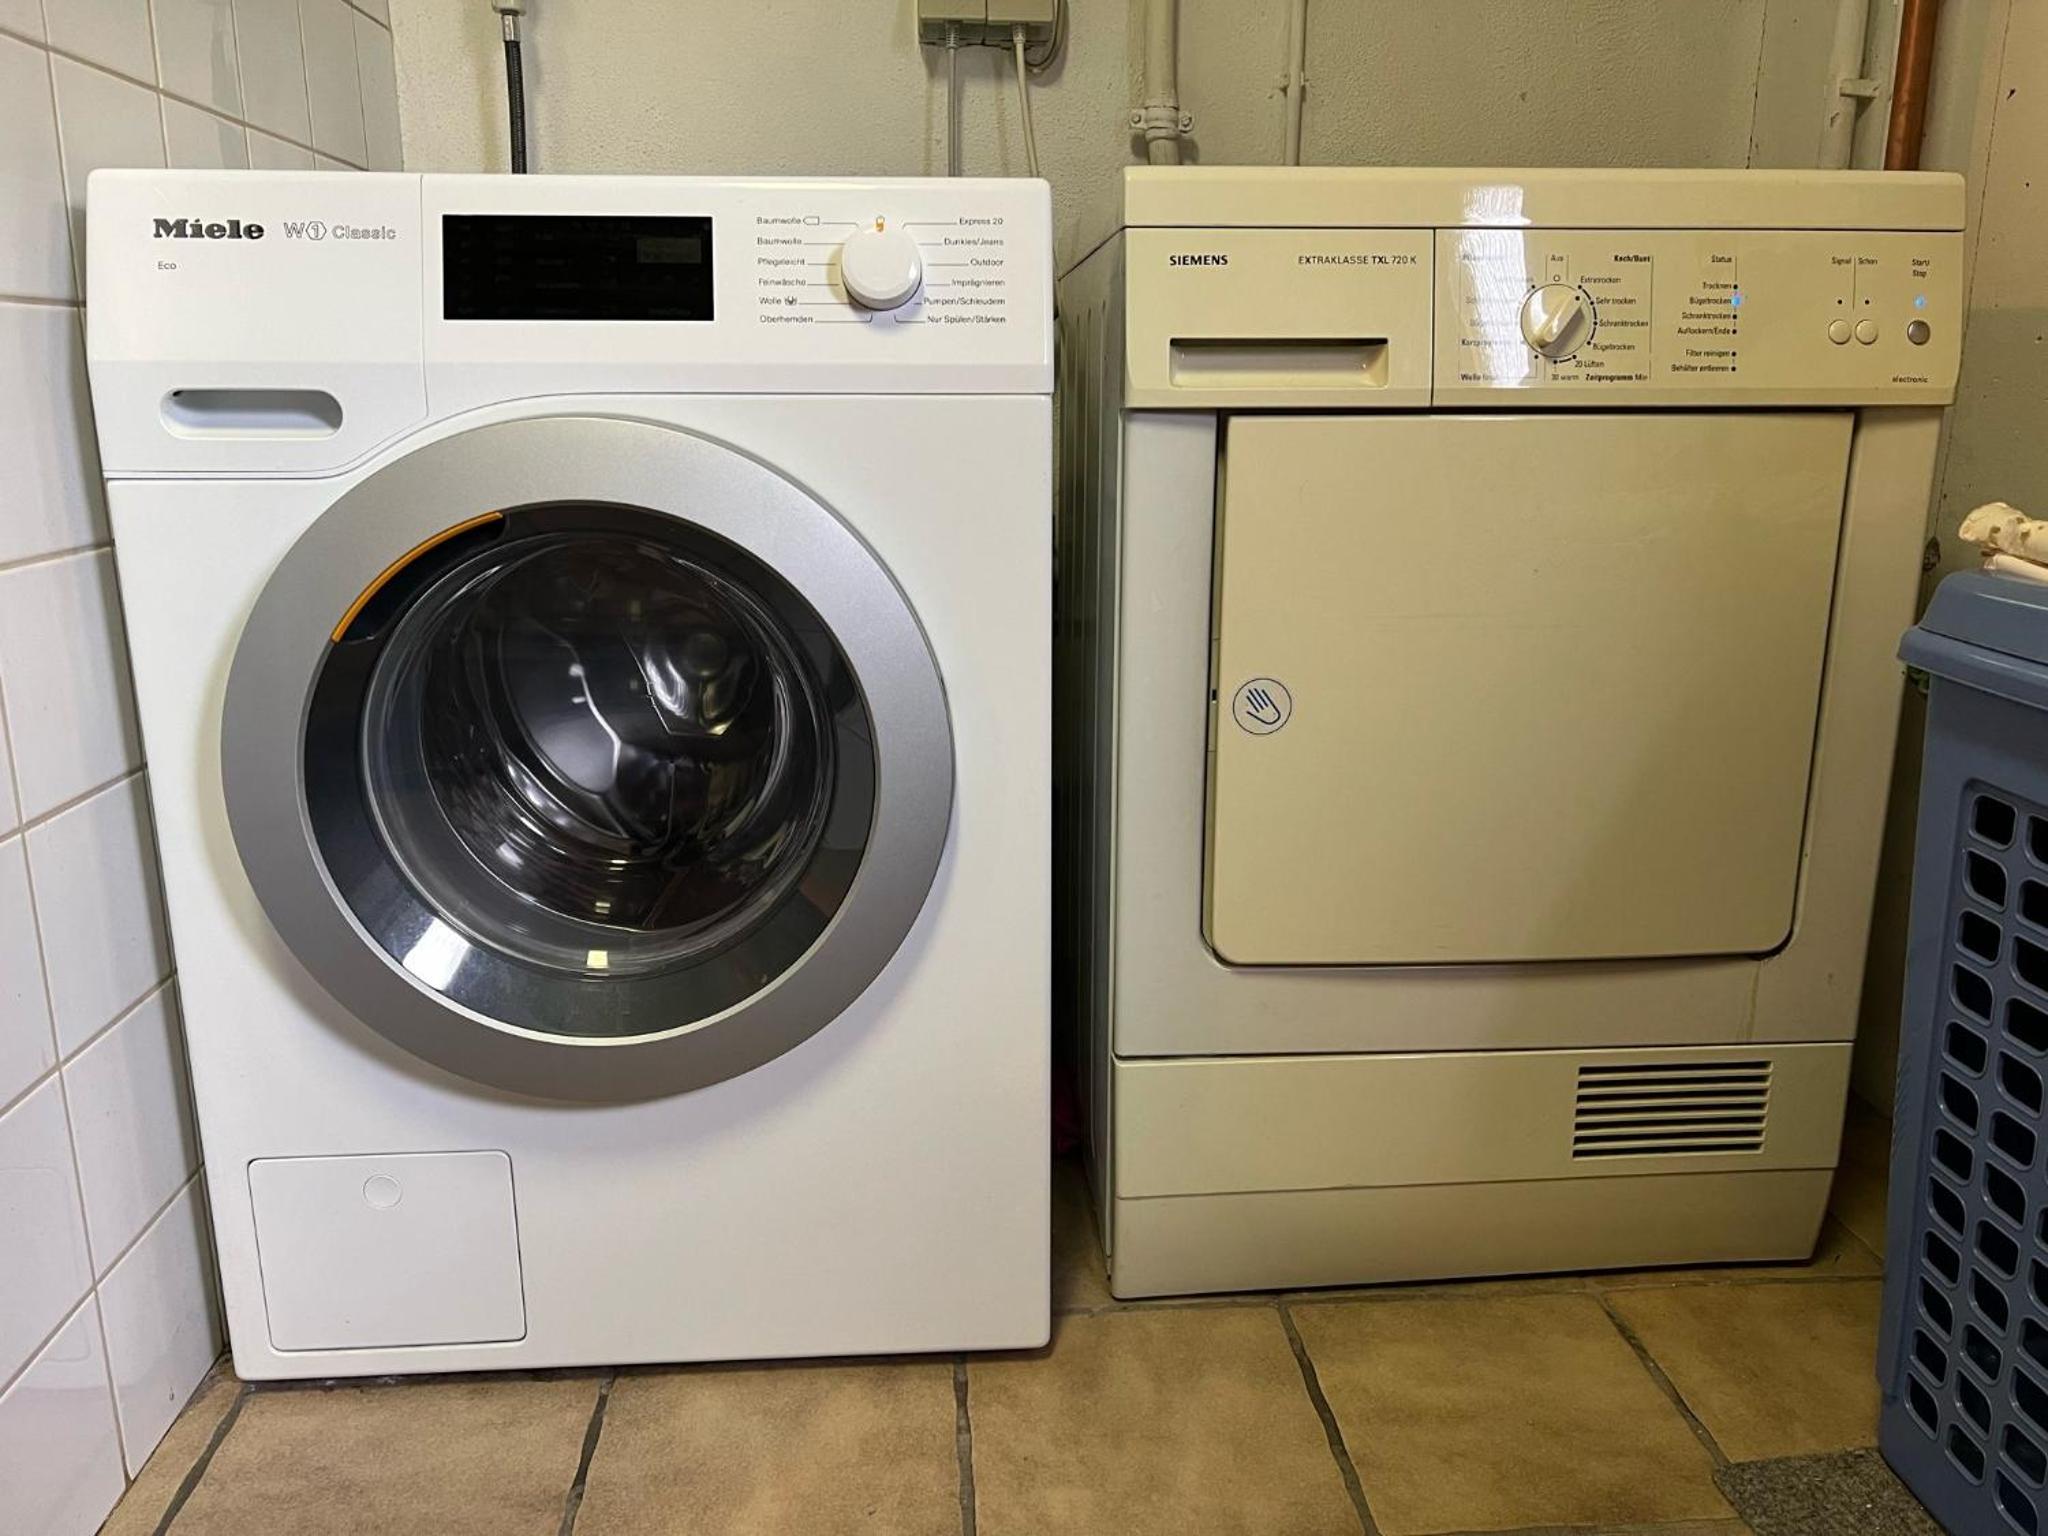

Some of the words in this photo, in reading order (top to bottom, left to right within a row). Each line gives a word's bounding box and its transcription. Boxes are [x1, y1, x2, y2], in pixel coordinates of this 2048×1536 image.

[959, 218, 991, 226] Express
[153, 218, 264, 239] Miele
[332, 225, 396, 239] Classic
[757, 237, 802, 245] Baumwolle
[944, 237, 1004, 246] Dunkles/Jeans
[1169, 255, 1229, 266] SIEMENS
[1298, 255, 1369, 265] EXTRAKLASSE
[1372, 255, 1389, 265] TXL
[1391, 256, 1408, 265] 720
[1409, 256, 1417, 265] K
[1711, 255, 1732, 263] Status
[1831, 256, 1852, 265] Signal
[157, 261, 177, 270] Eco
[1912, 269, 1927, 278] Stop
[952, 278, 1005, 288] Imprägnieren
[759, 297, 782, 305] Wolle
[924, 297, 1006, 306] Pumpen/Schleudern
[760, 315, 813, 323] Oberhemden
[927, 315, 942, 323] Nur
